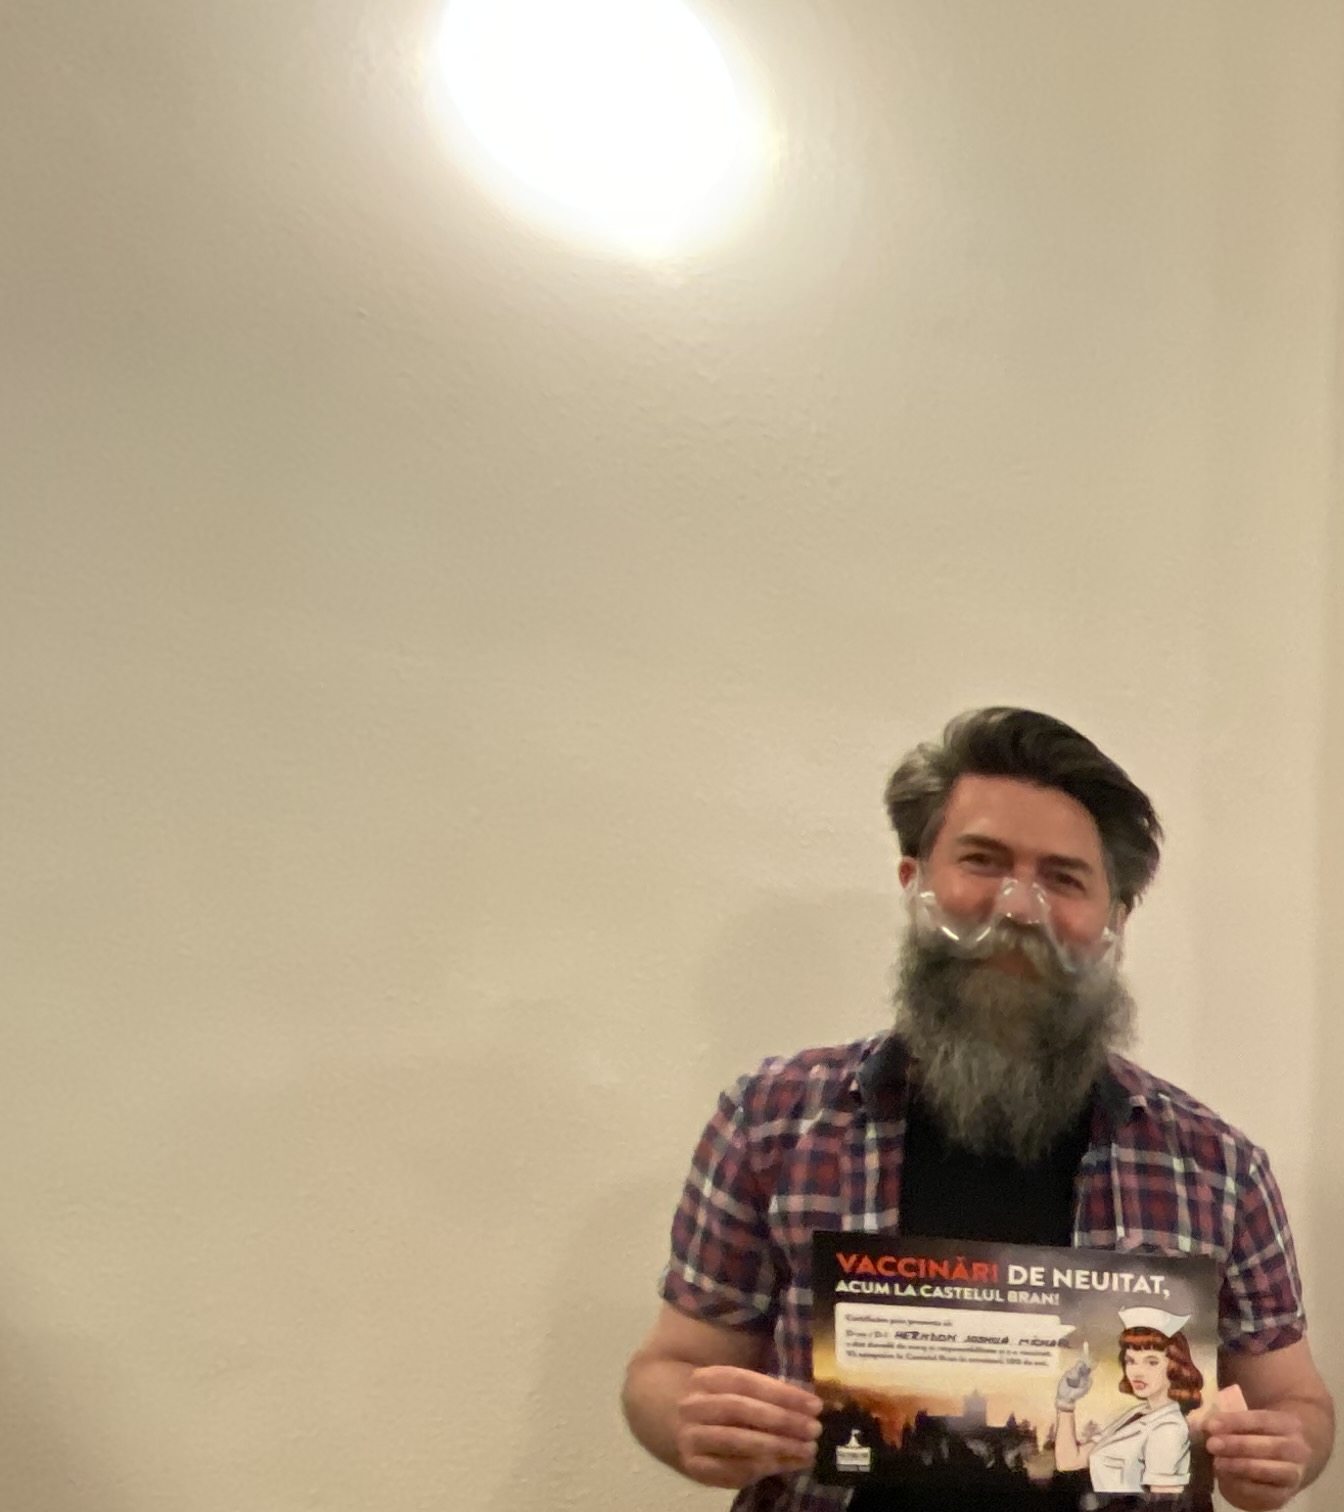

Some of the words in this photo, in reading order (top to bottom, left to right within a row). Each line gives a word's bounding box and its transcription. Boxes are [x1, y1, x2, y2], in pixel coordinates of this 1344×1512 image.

[835, 1280, 890, 1295] ACUM
[893, 1283, 917, 1297] LA
[919, 1285, 1005, 1302] CASTELUL
[1007, 1290, 1060, 1306] BRAN!
[836, 1252, 999, 1282] VACCINĂRI
[1007, 1263, 1046, 1287] DE
[1053, 1267, 1171, 1301] NEUITAT,
